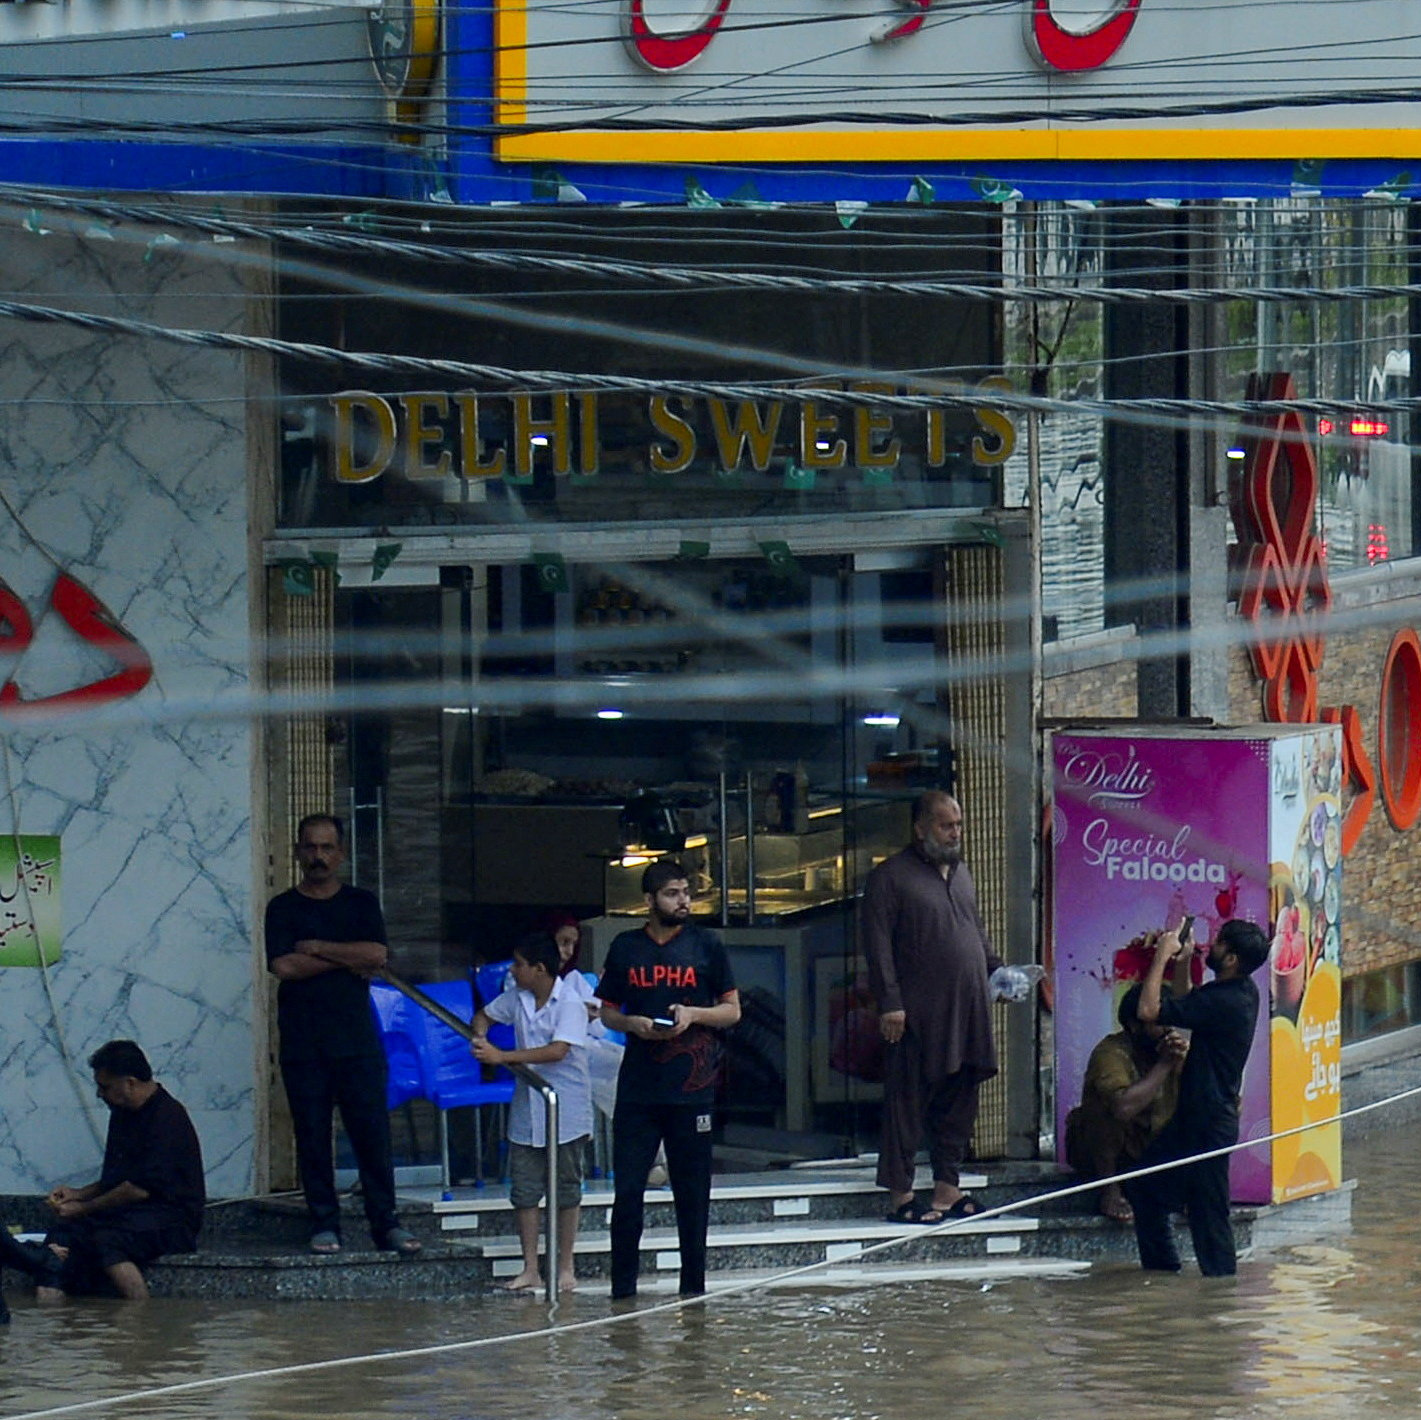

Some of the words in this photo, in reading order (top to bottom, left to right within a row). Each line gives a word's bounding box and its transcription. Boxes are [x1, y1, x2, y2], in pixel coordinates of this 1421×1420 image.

[330, 389, 600, 484] DELHI
[648, 376, 1017, 474] SWEETS
[1064, 745, 1156, 790] Delhi
[1082, 817, 1192, 866] Special
[1106, 855, 1226, 883] Falooda
[628, 964, 698, 988] ALPHA
